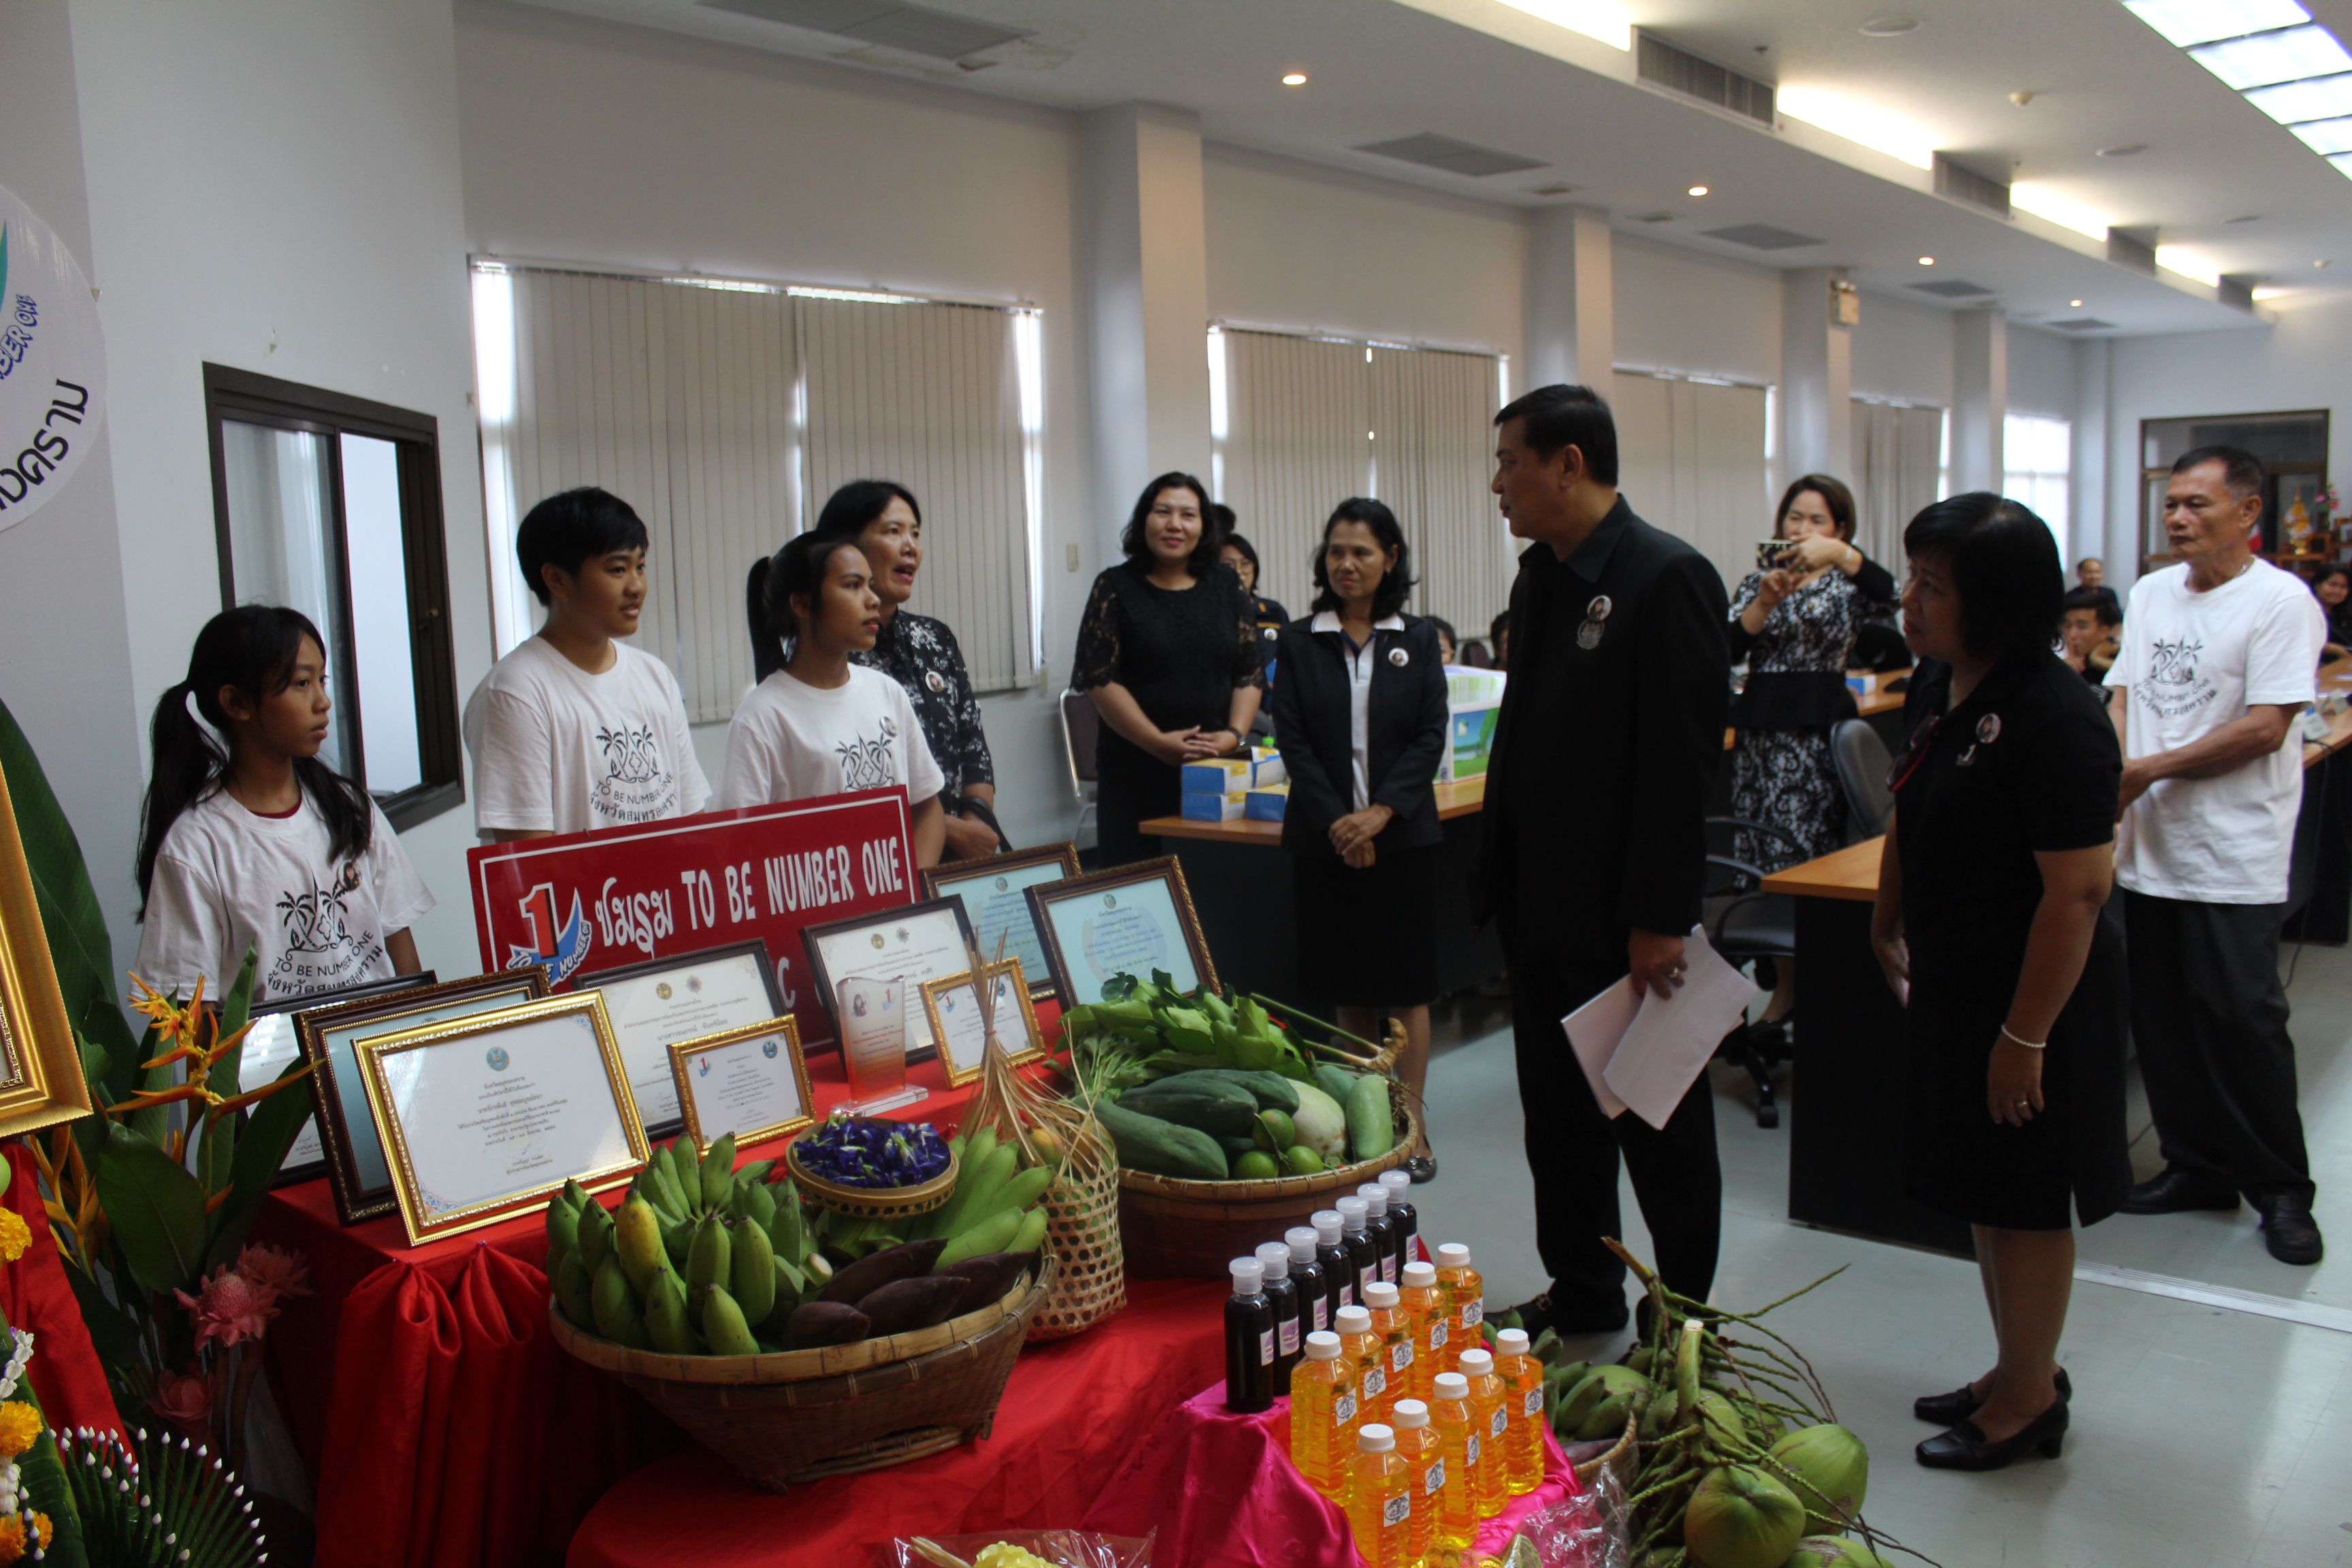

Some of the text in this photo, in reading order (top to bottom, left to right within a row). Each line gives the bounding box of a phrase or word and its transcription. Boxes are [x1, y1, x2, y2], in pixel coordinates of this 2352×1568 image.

[0, 294, 39, 380] BER ONE
[0, 378, 88, 510] งคราม
[595, 781, 611, 796] TO
[614, 791, 624, 802] BE
[681, 836, 902, 930] TO BE NUMBER ONE
[275, 930, 374, 977] TO BE NUMBER ONE
